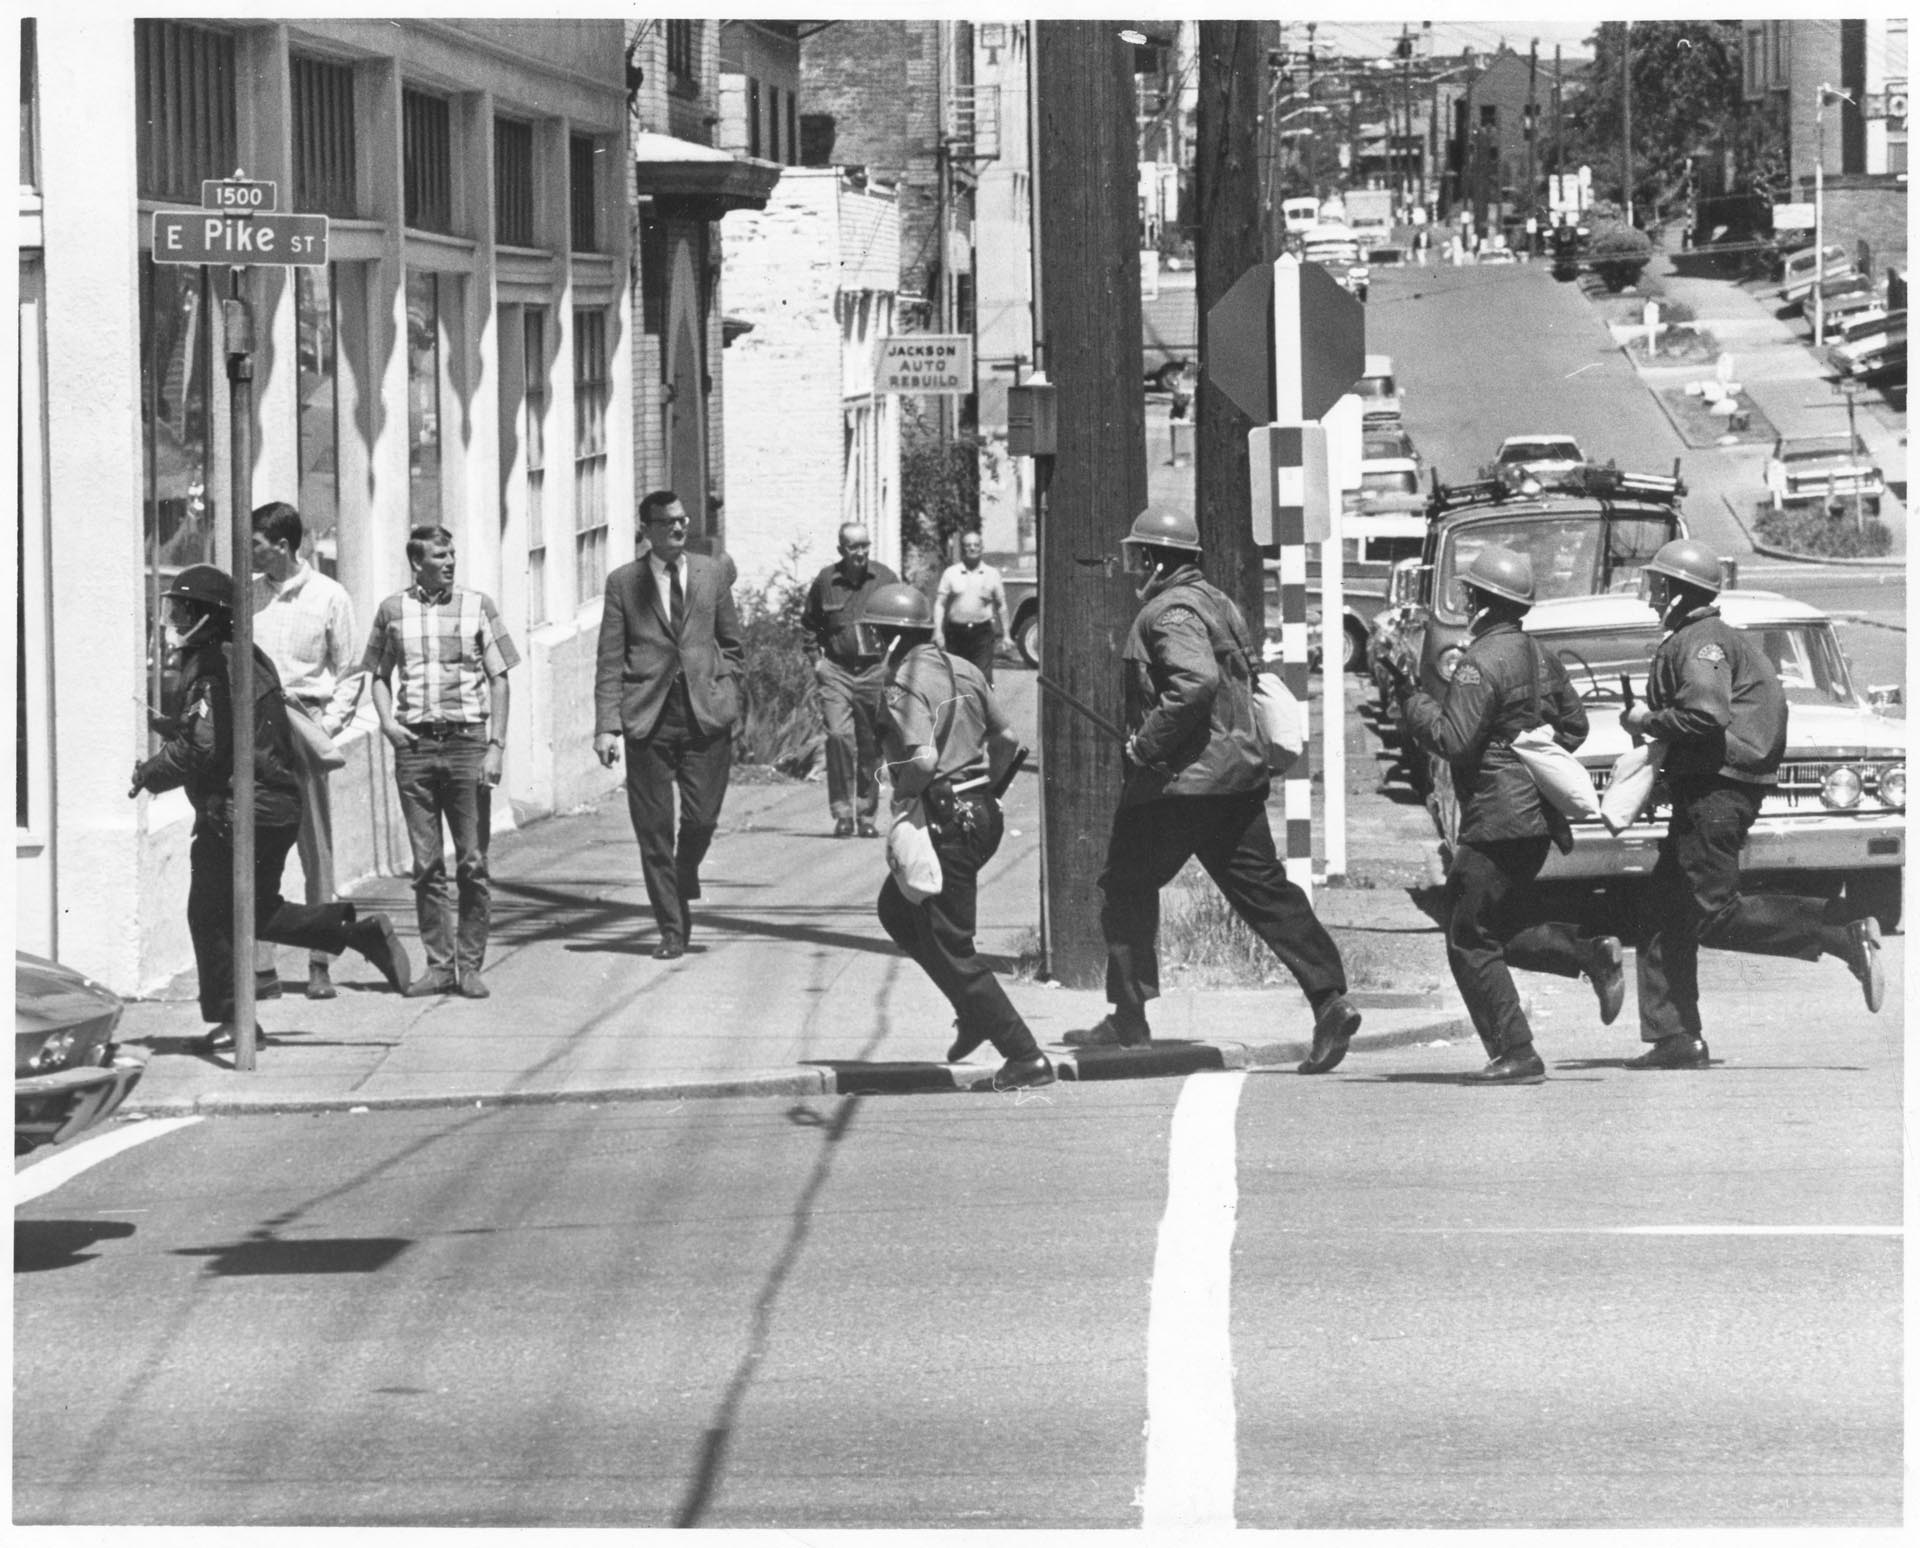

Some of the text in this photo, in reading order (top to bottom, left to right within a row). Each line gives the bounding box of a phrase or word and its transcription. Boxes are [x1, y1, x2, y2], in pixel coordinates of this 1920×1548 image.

[216, 188, 262, 205] 1500
[167, 219, 315, 252] E Pike ST
[888, 346, 956, 357] JACKSON
[900, 360, 946, 372] AUTO
[889, 375, 959, 388] REBUILD
